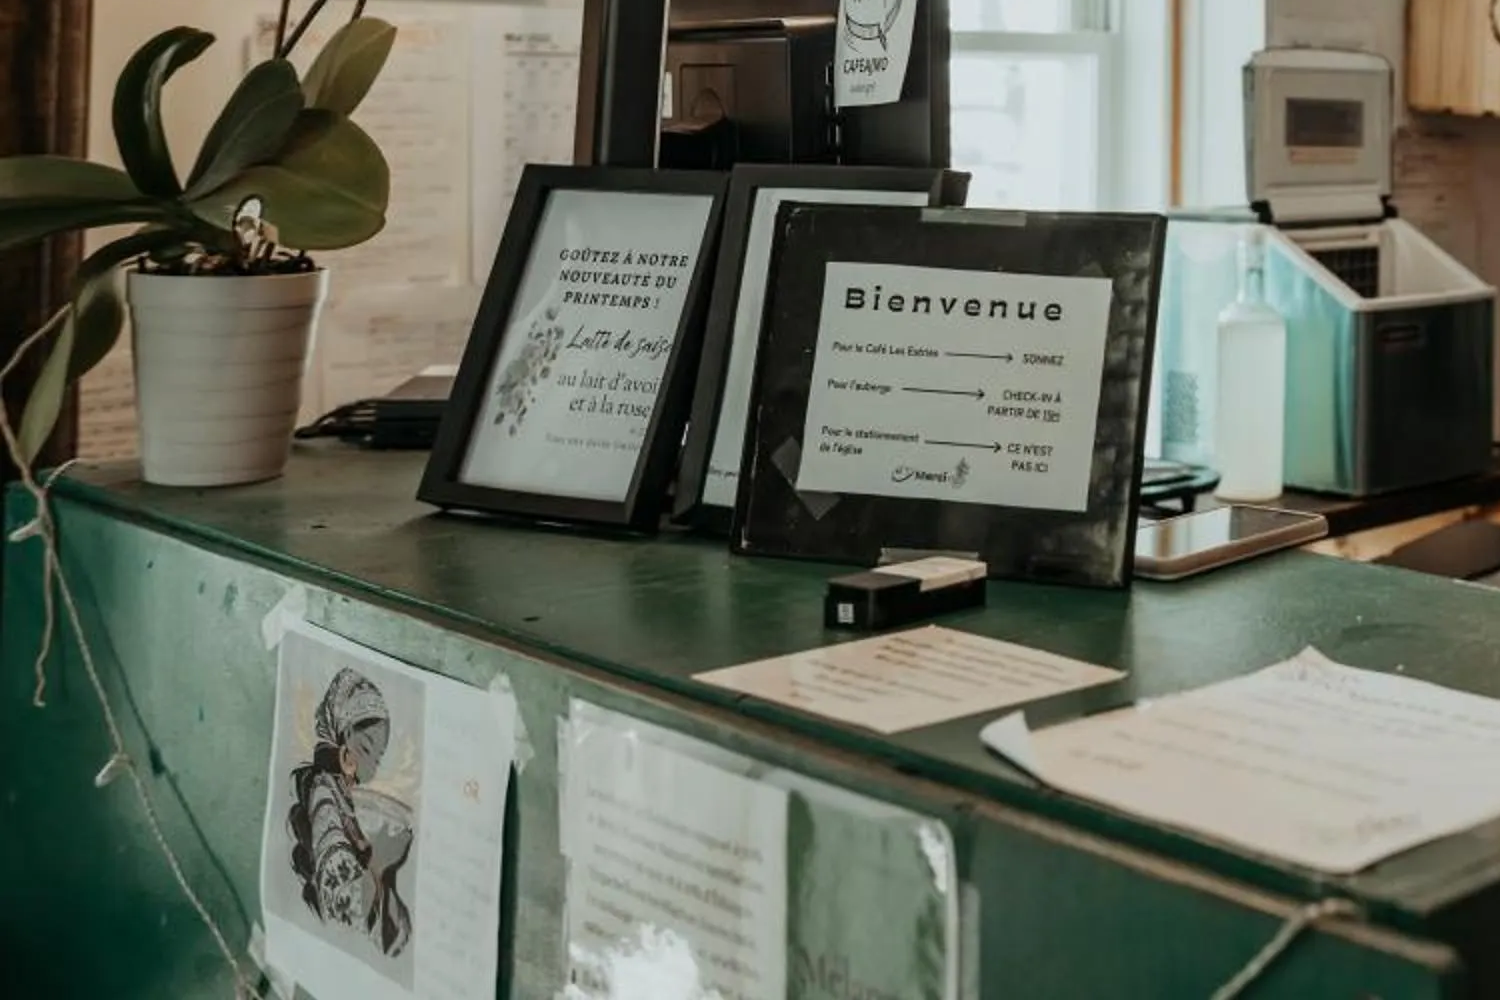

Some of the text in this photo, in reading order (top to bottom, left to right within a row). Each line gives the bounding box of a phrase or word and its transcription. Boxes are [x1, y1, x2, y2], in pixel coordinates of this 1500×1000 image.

[559, 247, 619, 265] GOÛTEZ
[637, 254, 690, 268] NOTRE
[559, 269, 677, 289] NOUVEAUTÉ DU
[562, 291, 650, 309] PRINTEMPS
[844, 285, 1063, 321] Bienvenue
[613, 328, 631, 352] de
[865, 343, 887, 355] Café
[556, 375, 577, 388] au
[579, 368, 606, 390] lait
[827, 378, 848, 390] Pour
[569, 398, 588, 412] et
[600, 394, 613, 414] la
